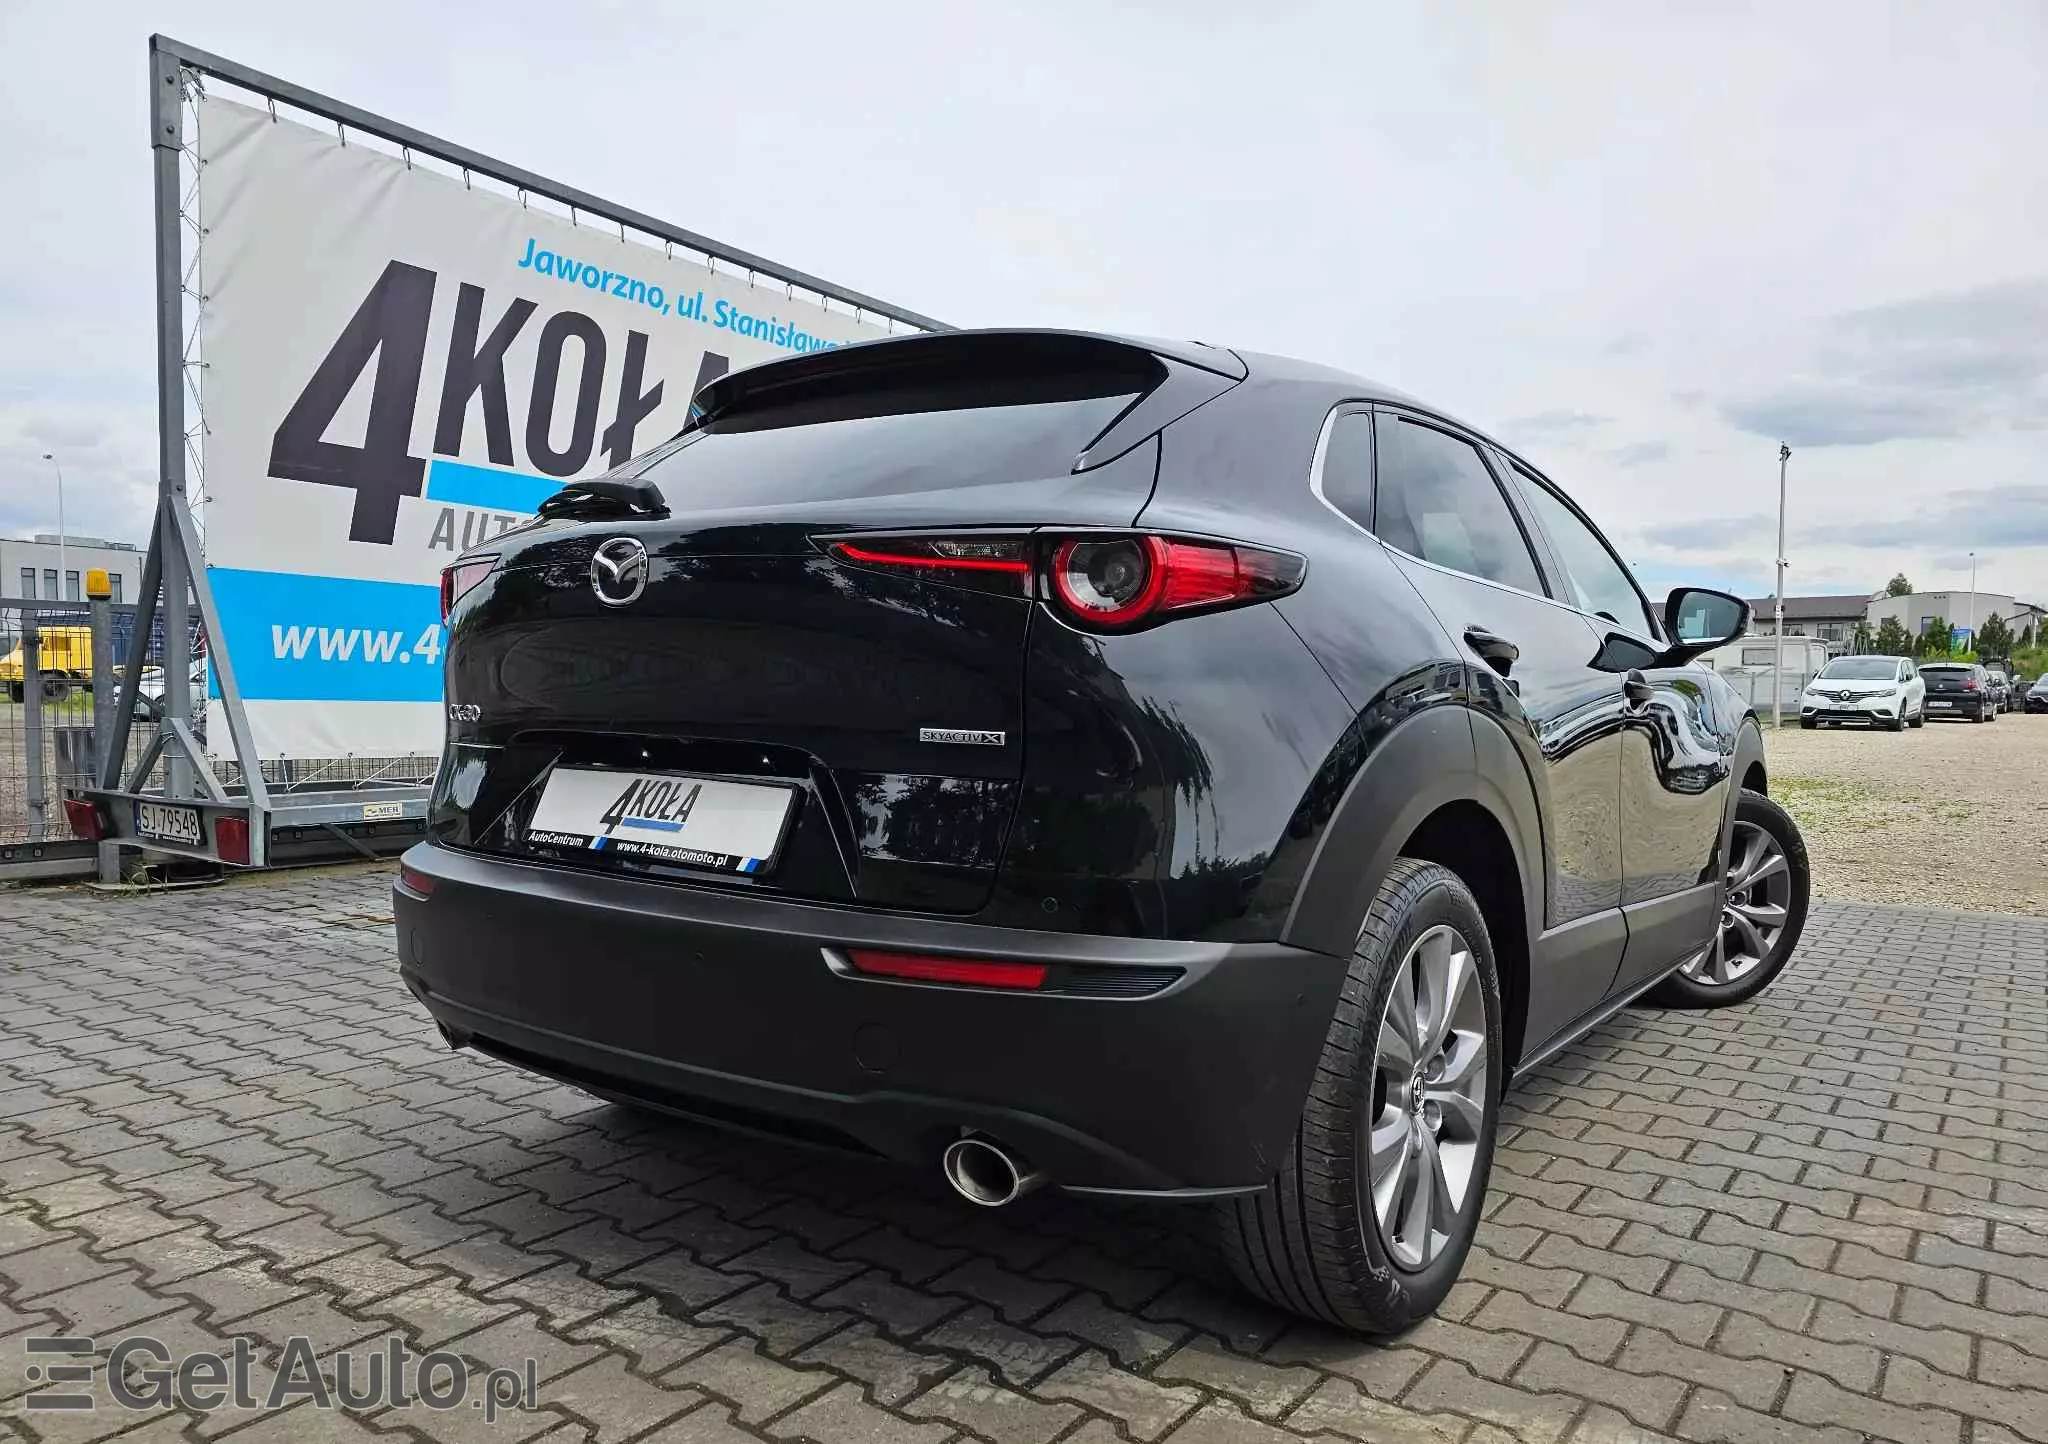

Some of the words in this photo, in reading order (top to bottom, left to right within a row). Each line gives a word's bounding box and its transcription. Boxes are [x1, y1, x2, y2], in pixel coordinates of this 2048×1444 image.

[518, 238, 670, 316] Jaworzno,
[677, 292, 707, 323] ul.
[428, 507, 535, 551] AUT
[600, 778, 703, 835] 4KOŁA
[528, 830, 584, 847] AutoCentrum
[617, 841, 728, 867] www.4-kola.otomoto.pl
